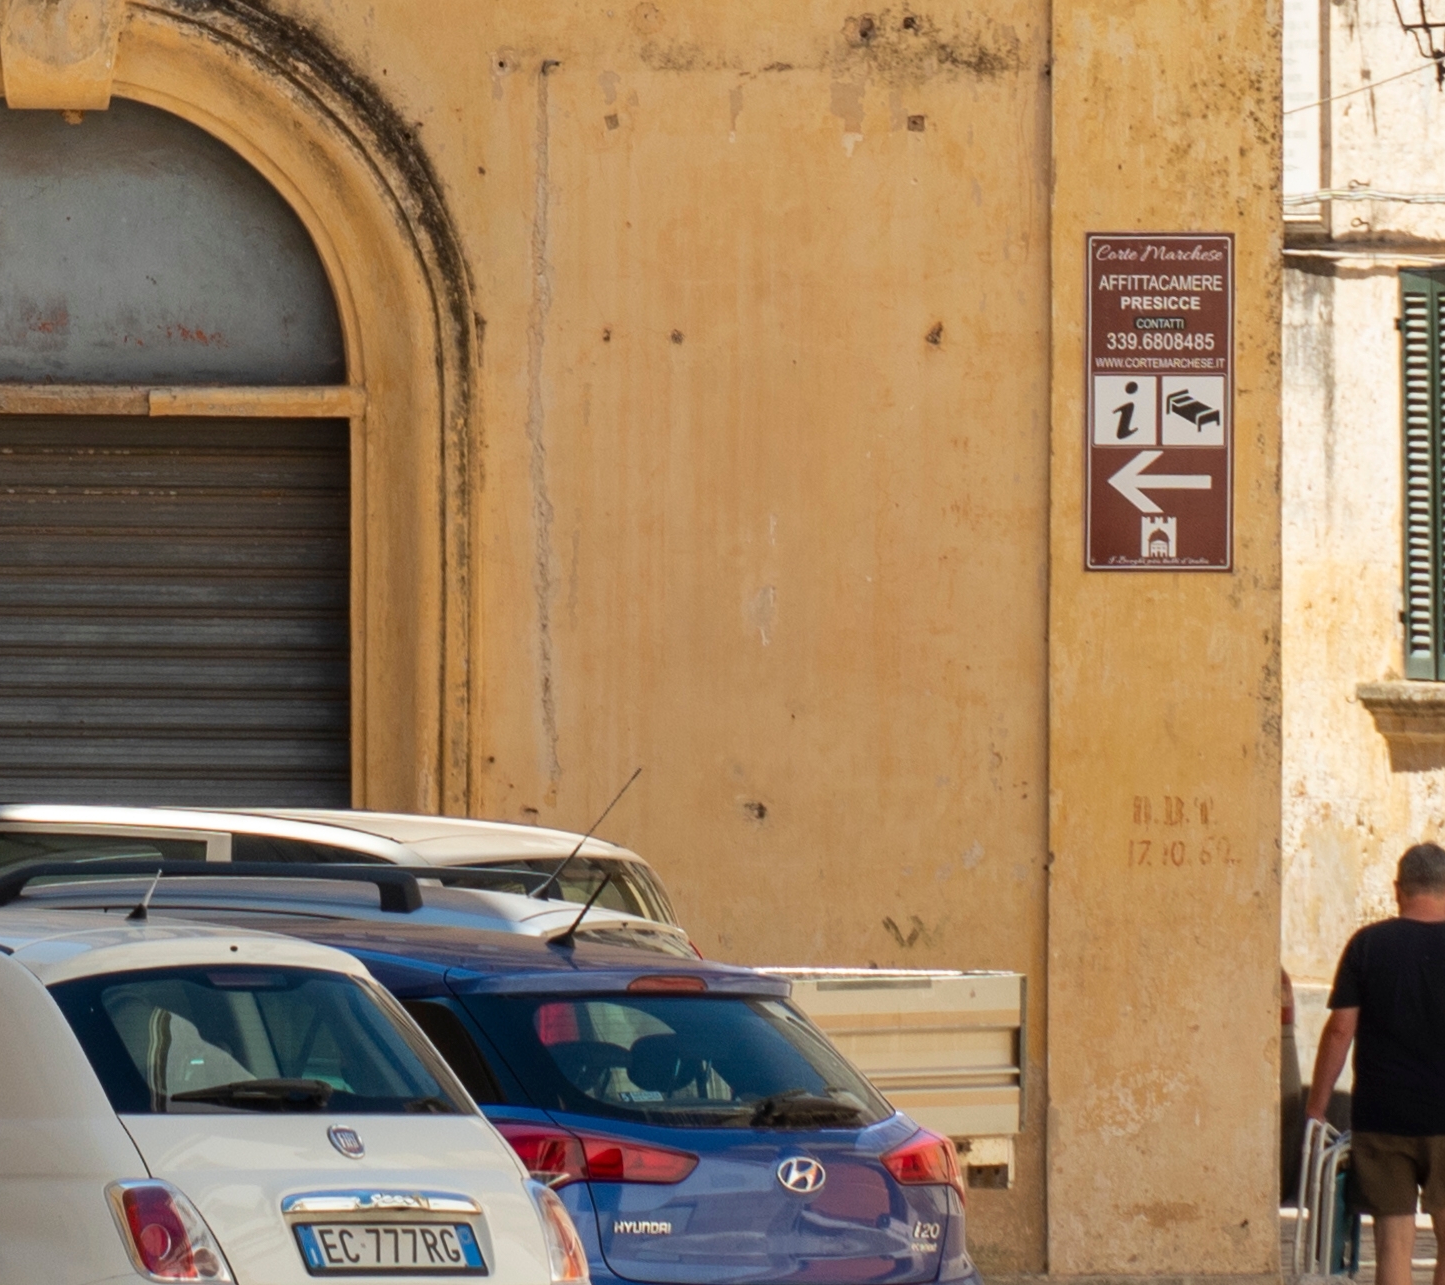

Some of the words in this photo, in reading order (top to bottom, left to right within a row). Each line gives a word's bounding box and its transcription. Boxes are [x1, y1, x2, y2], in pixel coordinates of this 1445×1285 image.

[1096, 245, 1138, 261] Corte
[1140, 245, 1223, 262] Marchese
[1099, 275, 1223, 291] AFFITTACAMERE
[1121, 296, 1201, 310] PRESICCE
[1136, 318, 1185, 329] CONTATTI
[1107, 332, 1215, 350] 339.6808485
[1095, 357, 1225, 369] WWW.CORTEMARCHESE.IT
[613, 1220, 671, 1234] HYUNDAI
[913, 1220, 940, 1239] i20
